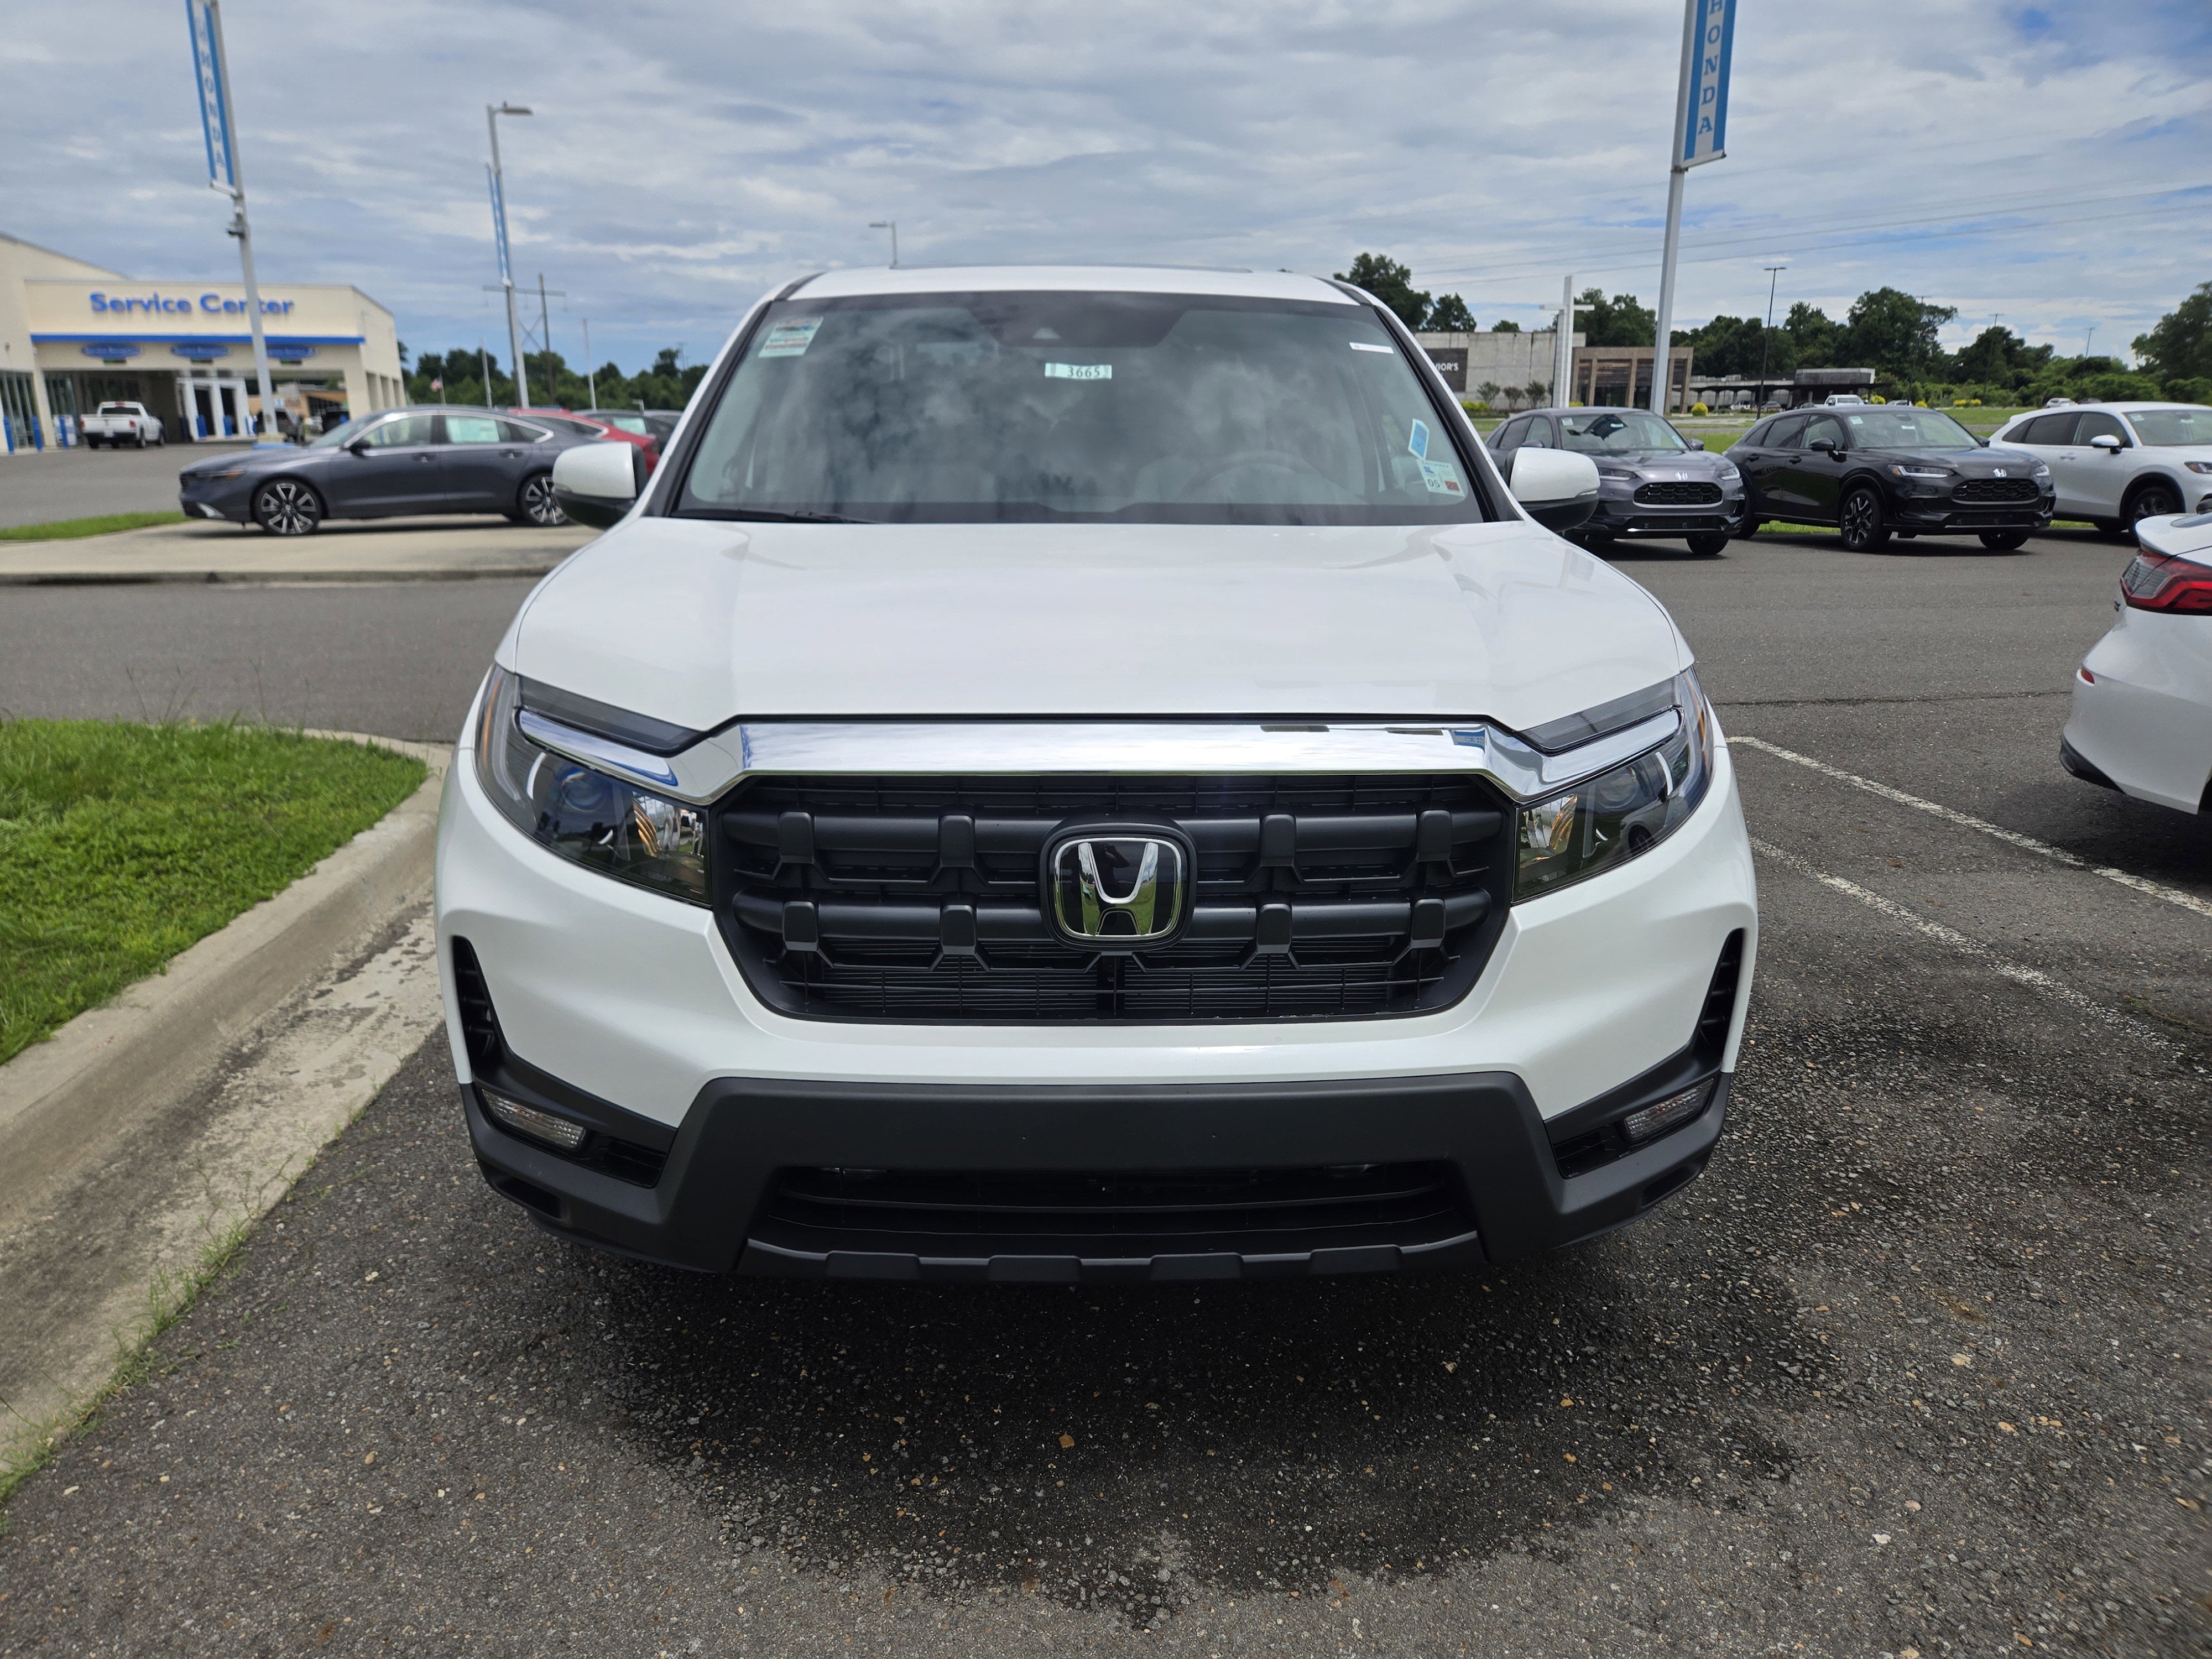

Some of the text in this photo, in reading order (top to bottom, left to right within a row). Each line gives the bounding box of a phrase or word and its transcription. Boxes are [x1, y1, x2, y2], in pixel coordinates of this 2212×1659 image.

[1698, 0, 1723, 134] HONDA
[90, 292, 192, 313] Service
[1067, 366, 1100, 378] 3665
[1428, 479, 1440, 488] 05
